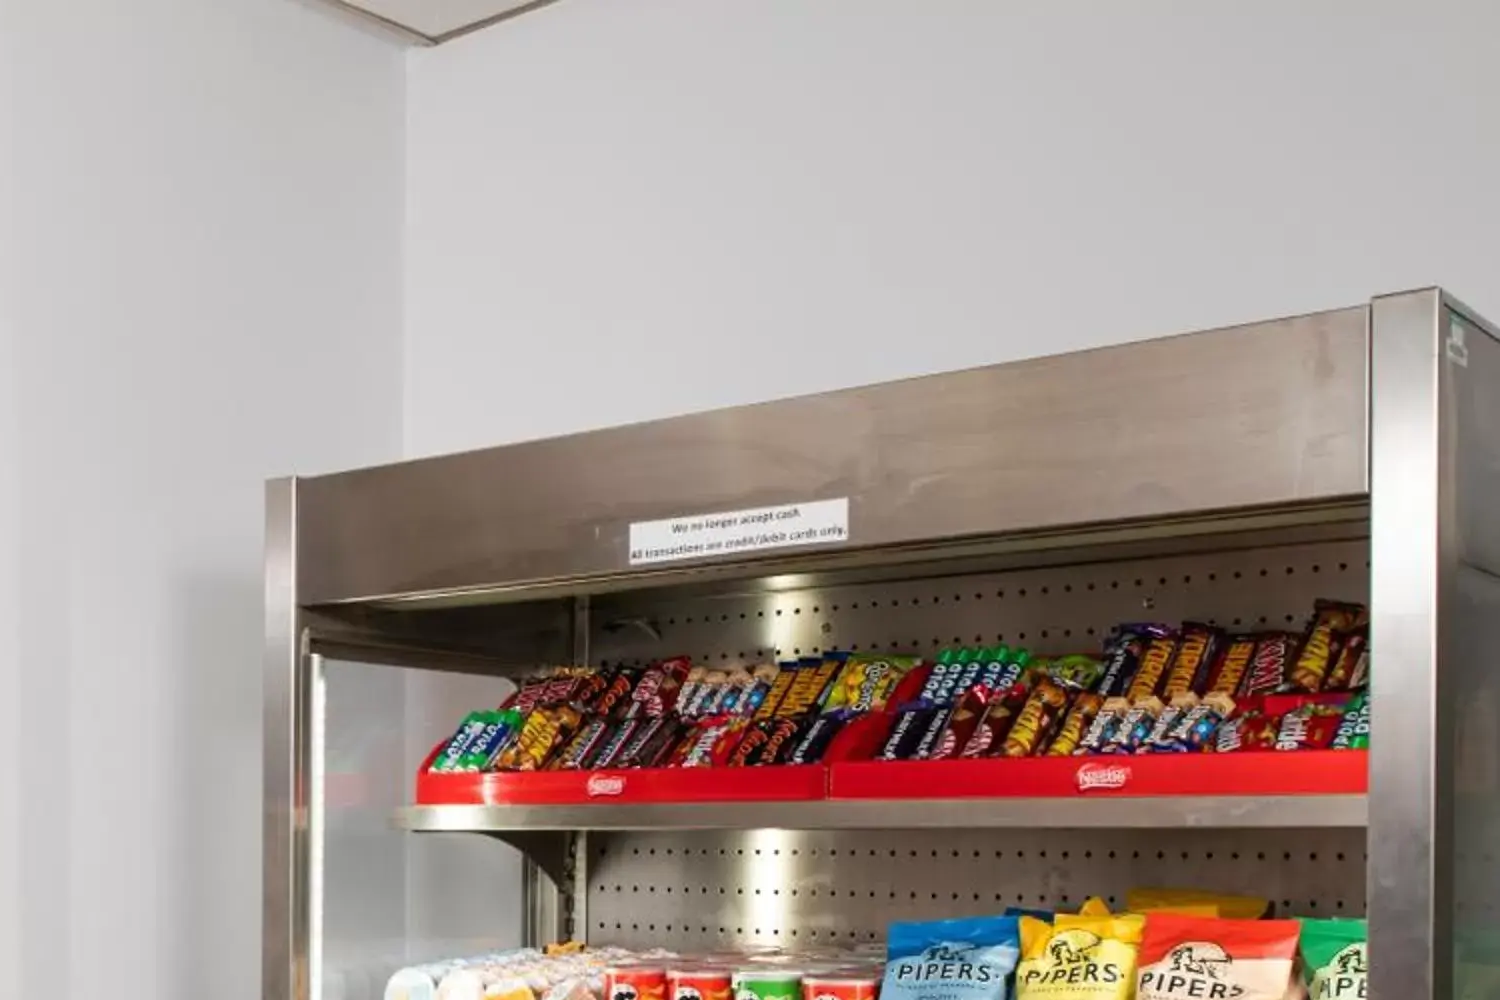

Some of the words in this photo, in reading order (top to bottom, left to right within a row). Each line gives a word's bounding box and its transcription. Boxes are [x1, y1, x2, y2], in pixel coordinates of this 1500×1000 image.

[671, 523, 688, 534] We
[690, 523, 704, 532] no
[705, 518, 738, 532] longer
[739, 511, 774, 526] accept
[775, 507, 801, 520] cash
[644, 542, 704, 558] transactions
[705, 541, 723, 550] are
[725, 531, 787, 549] credit/debit
[789, 528, 818, 542] cards
[919, 663, 947, 700] POLO
[898, 963, 992, 984] PIPERS
[1025, 963, 1120, 985] PIPERS
[1140, 972, 1245, 998] PIPERS
